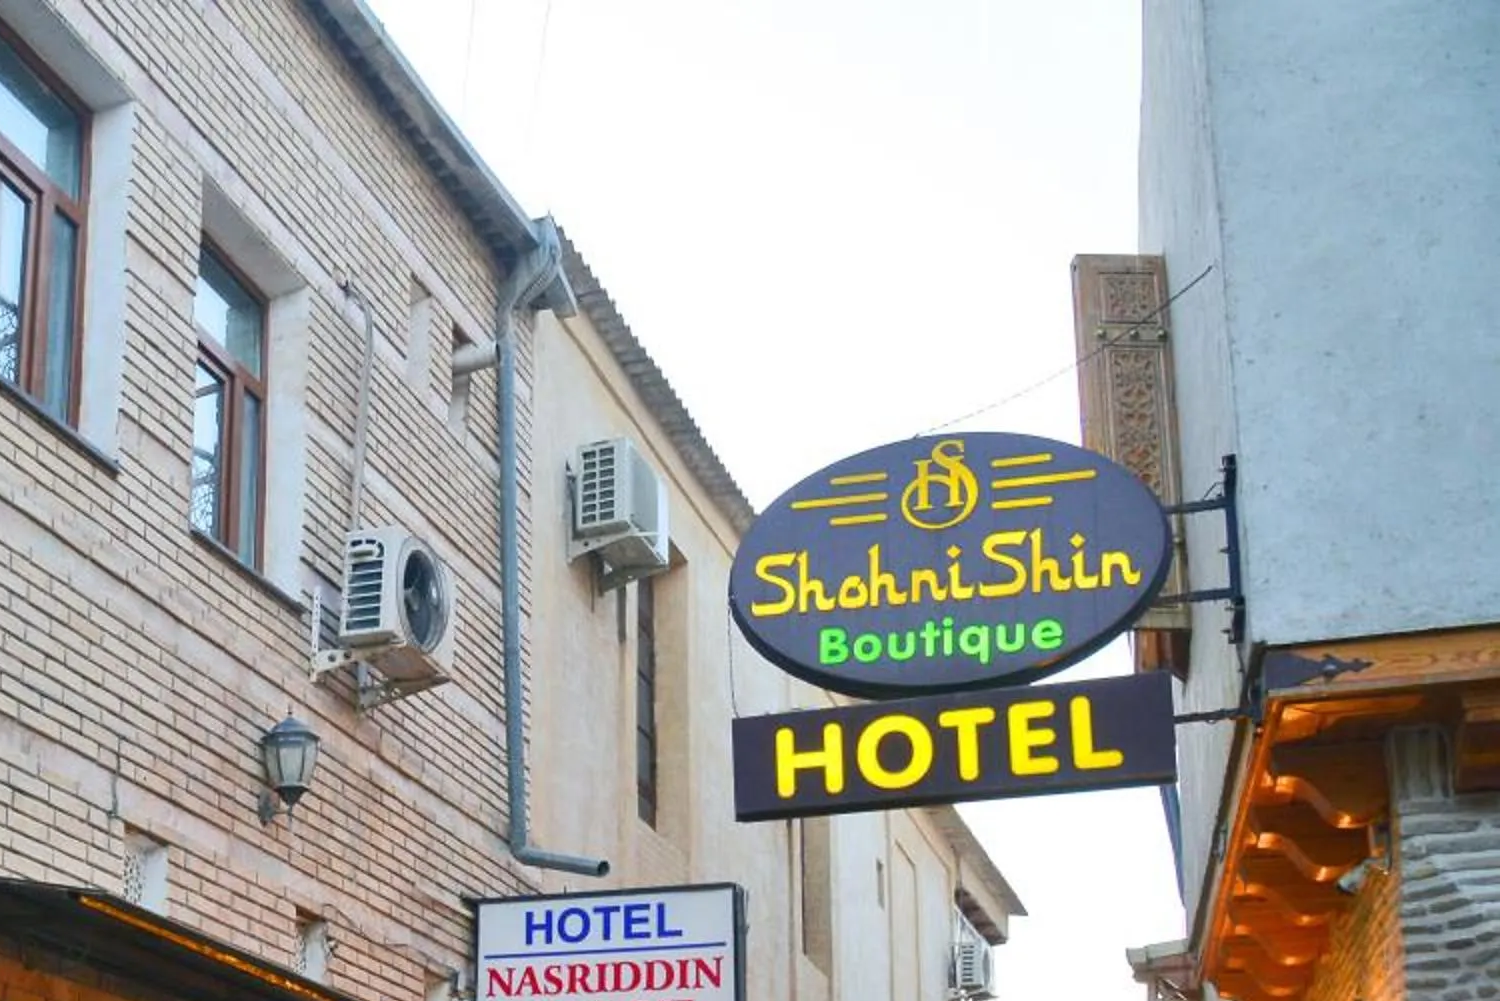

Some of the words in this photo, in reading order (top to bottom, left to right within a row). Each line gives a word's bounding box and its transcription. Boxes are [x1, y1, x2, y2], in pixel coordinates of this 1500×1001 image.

[818, 616, 1064, 664] Boutique
[775, 695, 1124, 798] HOTEL
[525, 903, 683, 945] HOTEL
[486, 957, 724, 997] NASRIDDIN
